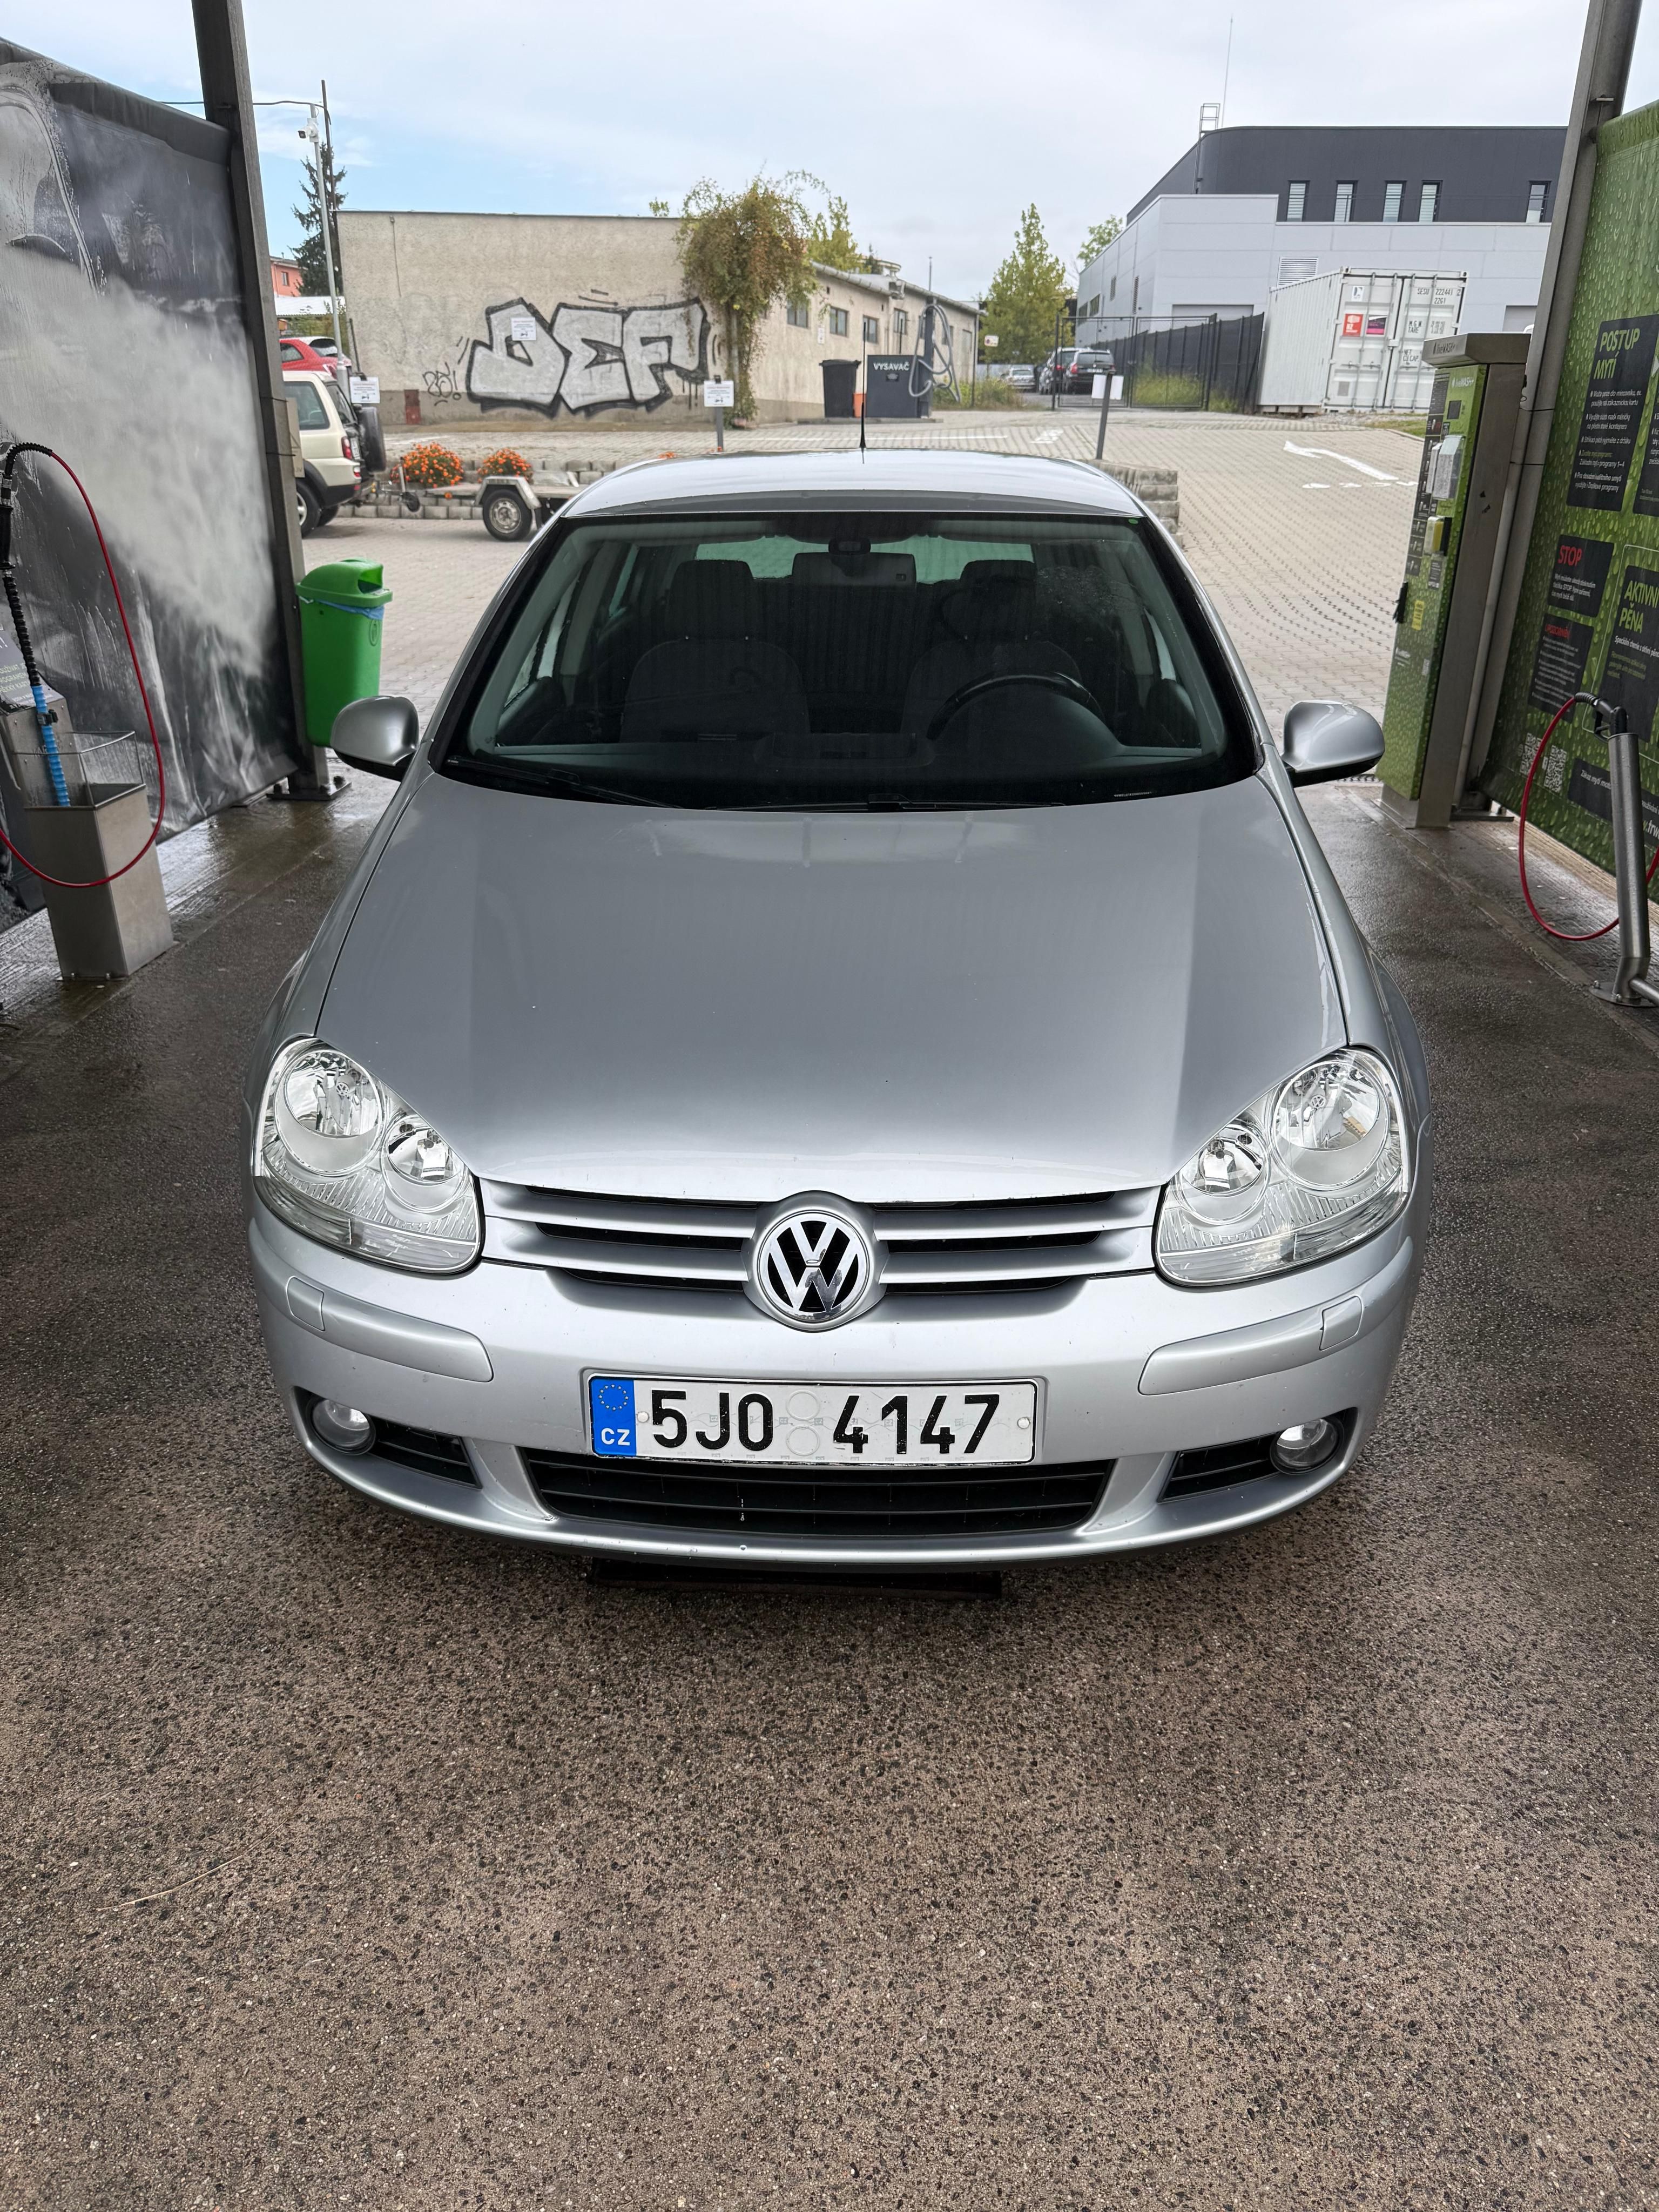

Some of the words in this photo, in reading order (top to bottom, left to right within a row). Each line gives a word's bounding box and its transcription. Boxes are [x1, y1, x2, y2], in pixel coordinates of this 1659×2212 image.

[1600, 328, 1640, 352] POSTUP
[873, 361, 909, 370] VYSAVAČ
[1594, 350, 1619, 379] MYTÍ
[1557, 544, 1582, 567] STOP
[1618, 602, 1644, 633] PĚNA
[758, 1209, 870, 1323] VW
[601, 1427, 631, 1446] CZ
[651, 1390, 774, 1452] 5J0
[833, 1393, 1001, 1454] 4147
